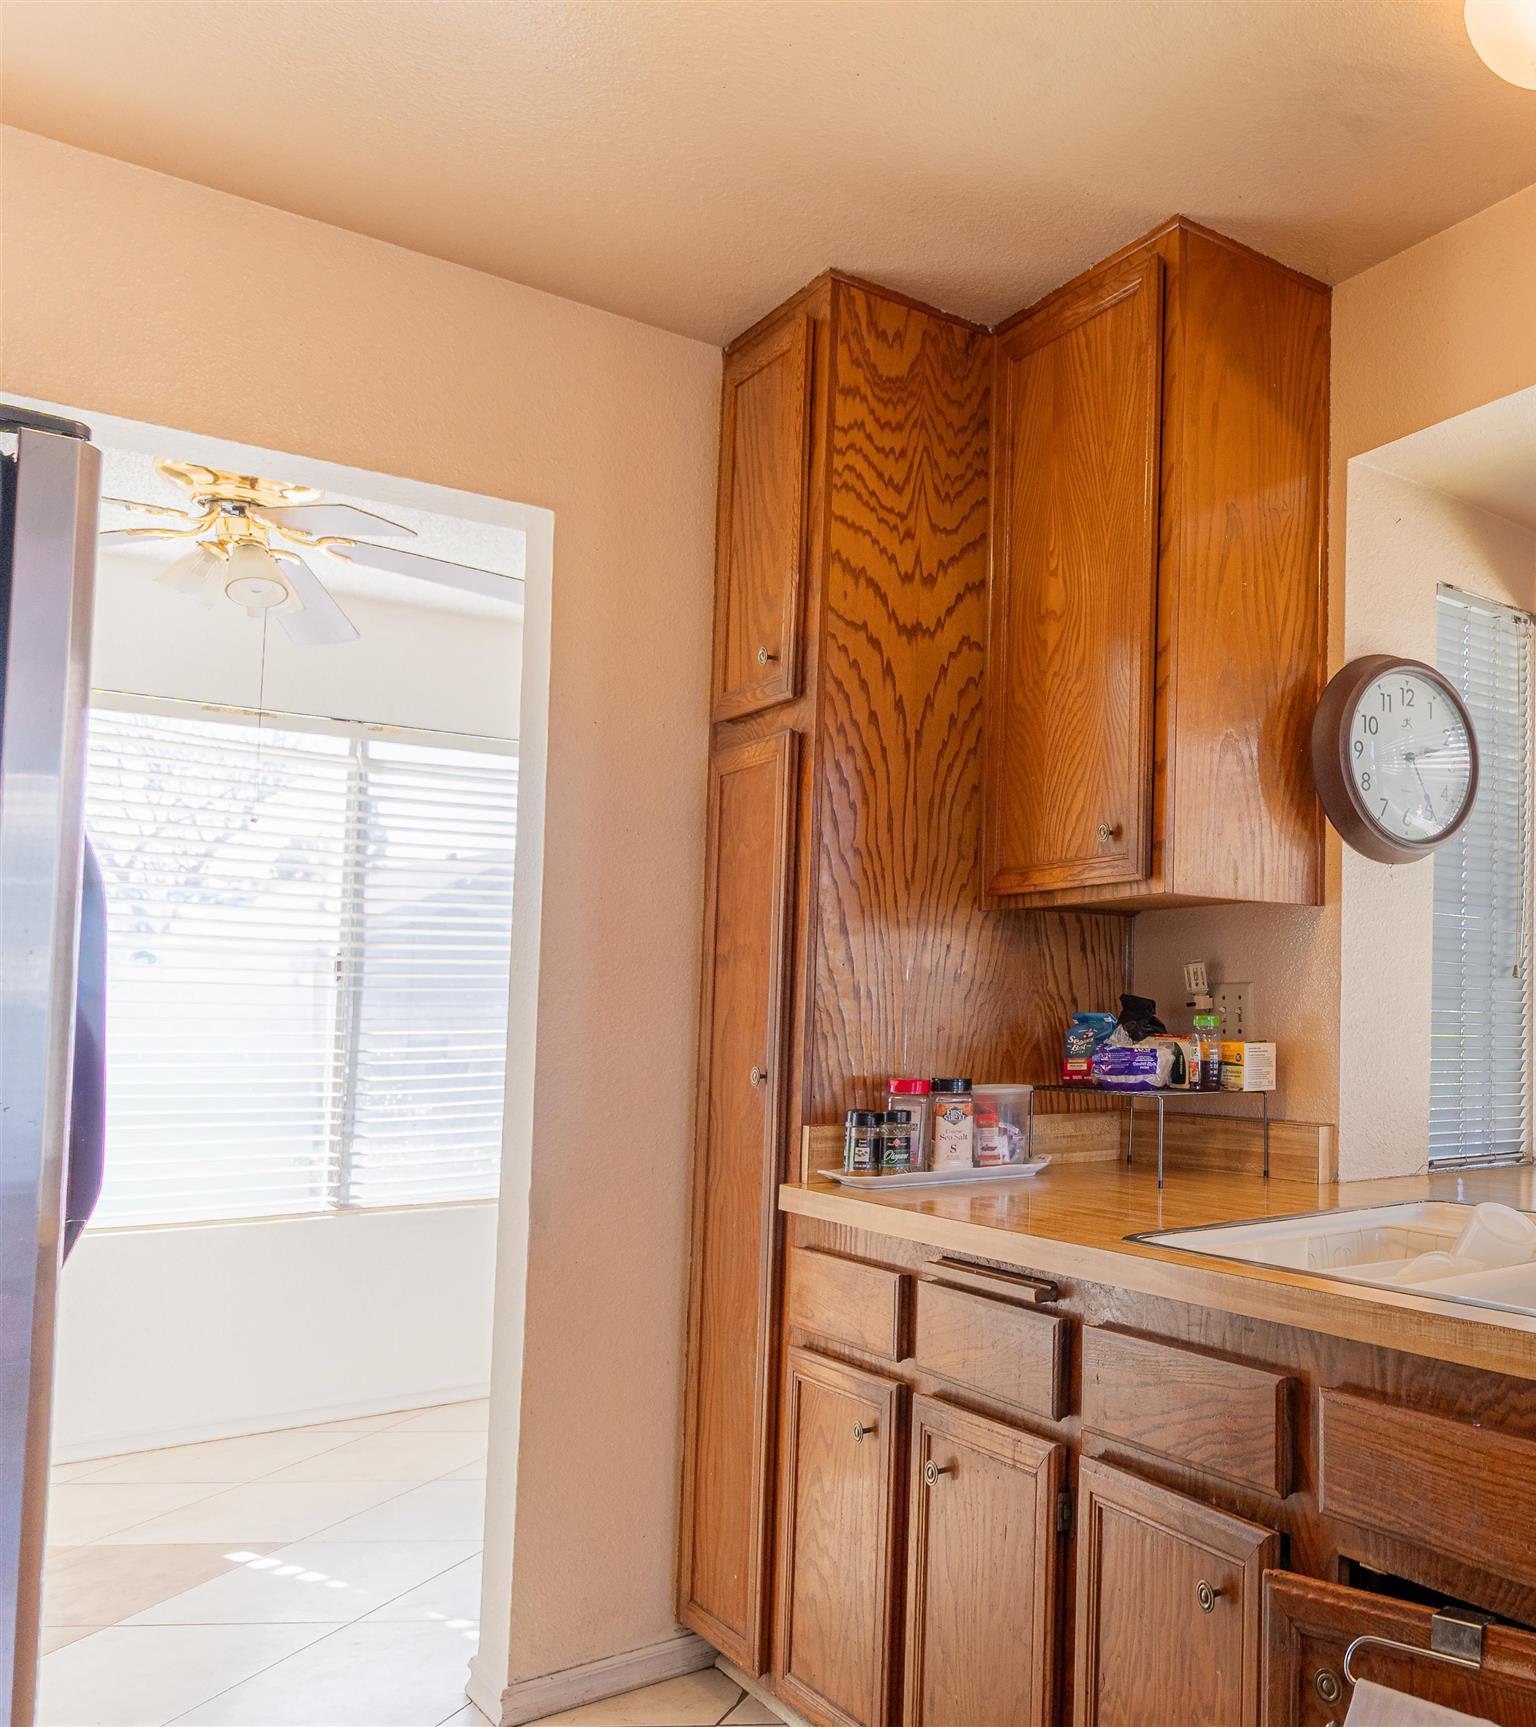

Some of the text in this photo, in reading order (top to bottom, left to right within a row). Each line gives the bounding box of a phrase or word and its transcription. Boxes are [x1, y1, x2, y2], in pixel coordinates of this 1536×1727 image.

[1380, 693, 1392, 713] 11
[1399, 686, 1415, 708] 12
[1427, 701, 1433, 720] 1
[1361, 714, 1379, 735] 10
[1353, 740, 1364, 760] 9
[1361, 772, 1371, 792] 8
[1440, 784, 1449, 801] 4
[1379, 798, 1389, 818] 7
[954, 1133, 968, 1141] Salt
[950, 1144, 957, 1154] S
